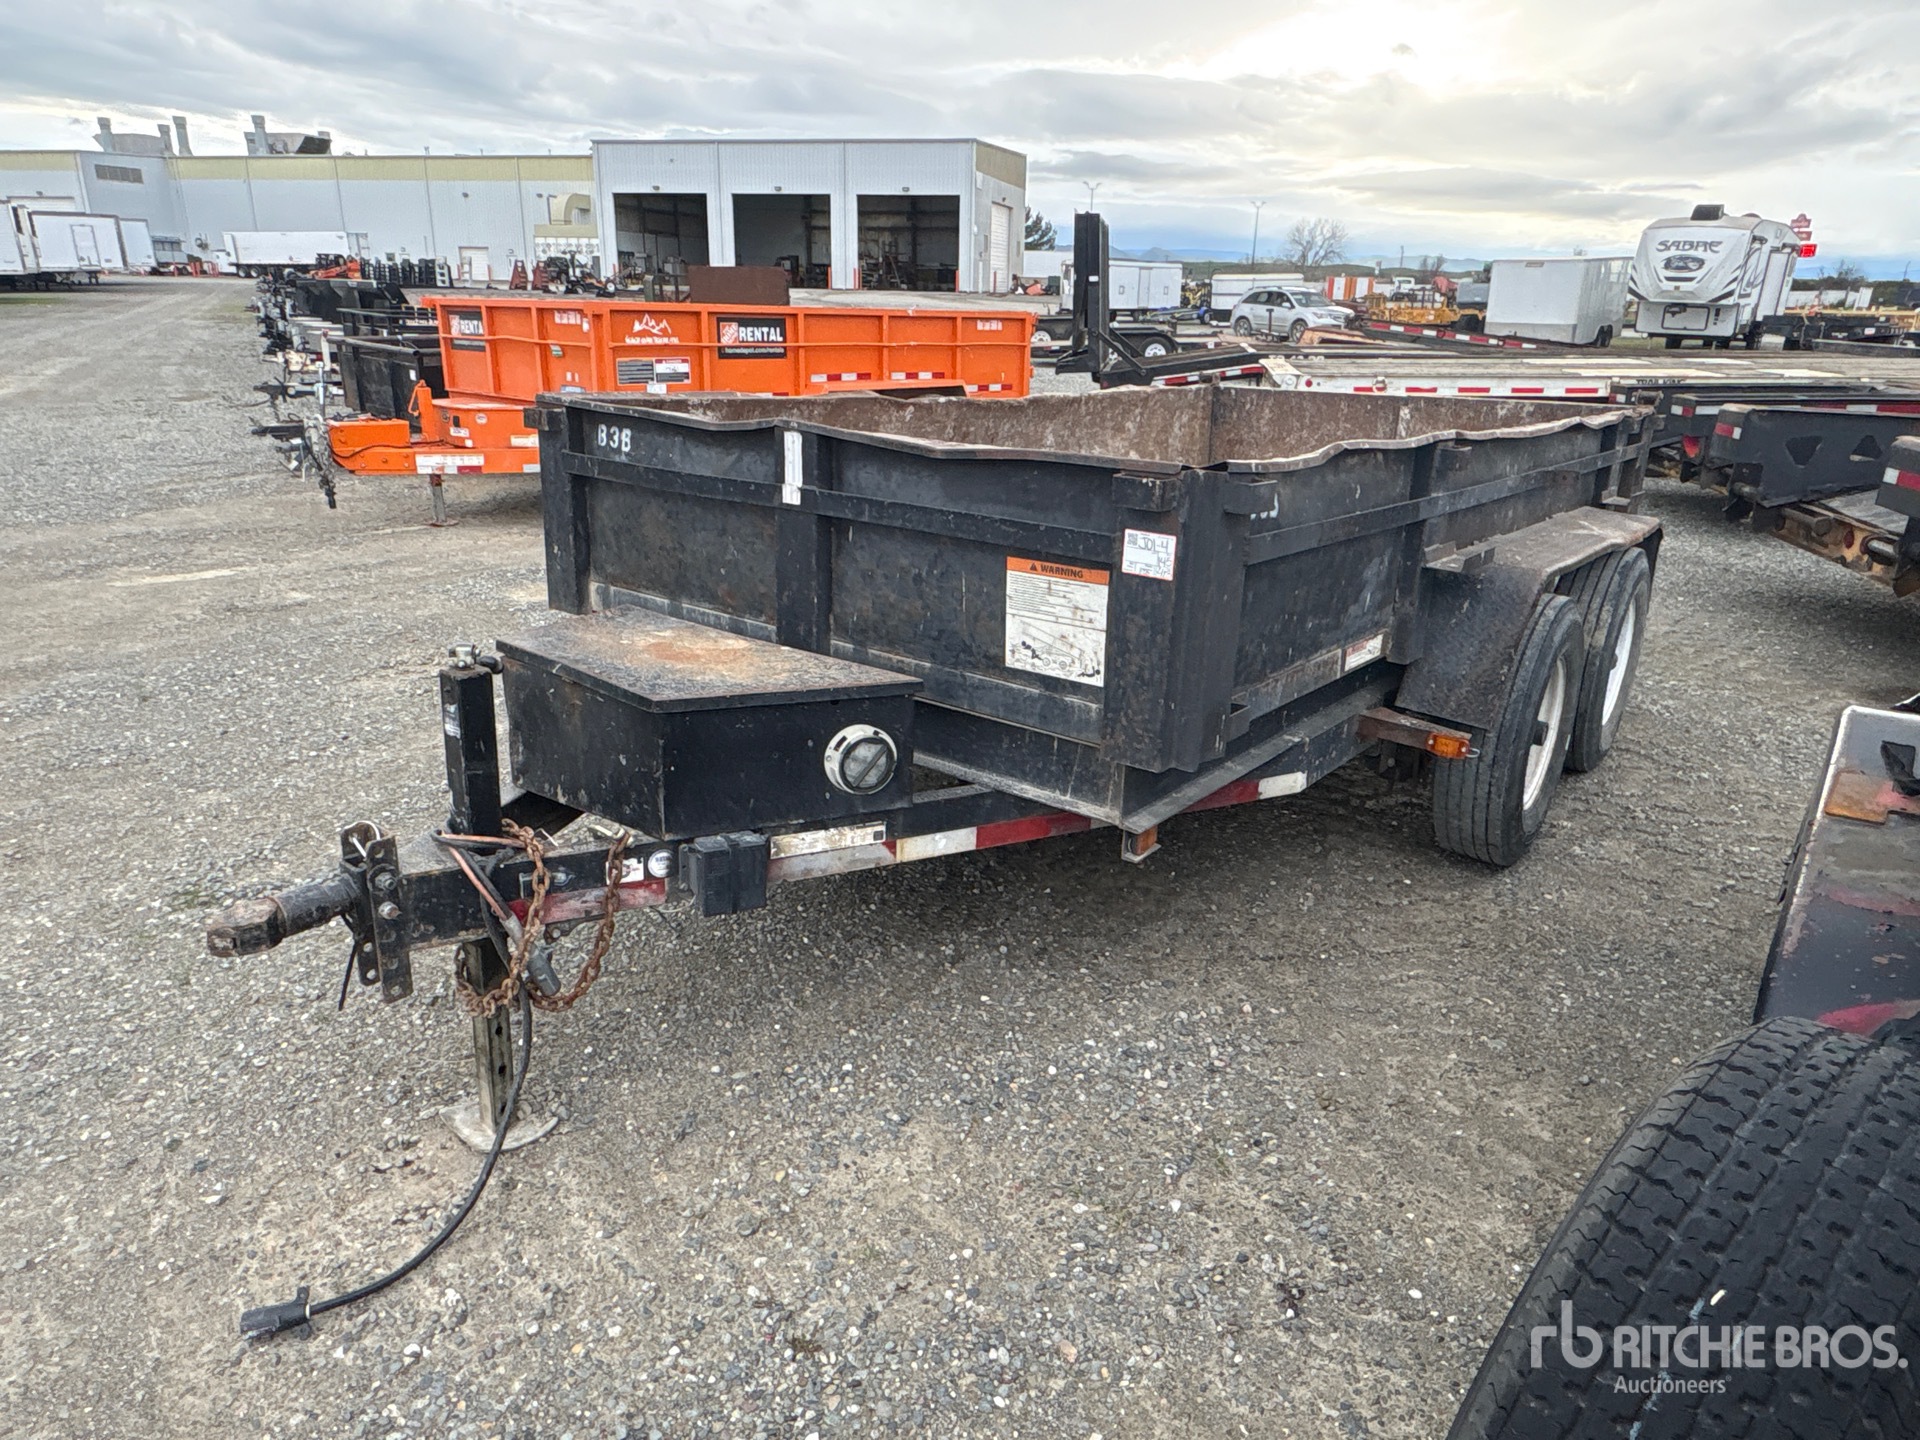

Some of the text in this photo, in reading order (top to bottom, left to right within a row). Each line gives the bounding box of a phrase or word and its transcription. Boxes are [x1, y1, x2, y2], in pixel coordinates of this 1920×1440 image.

[1655, 239, 1723, 254] SABRE
[460, 318, 484, 334] RENTA
[738, 326, 784, 342] RENTAL
[1040, 563, 1084, 579] WARNING
